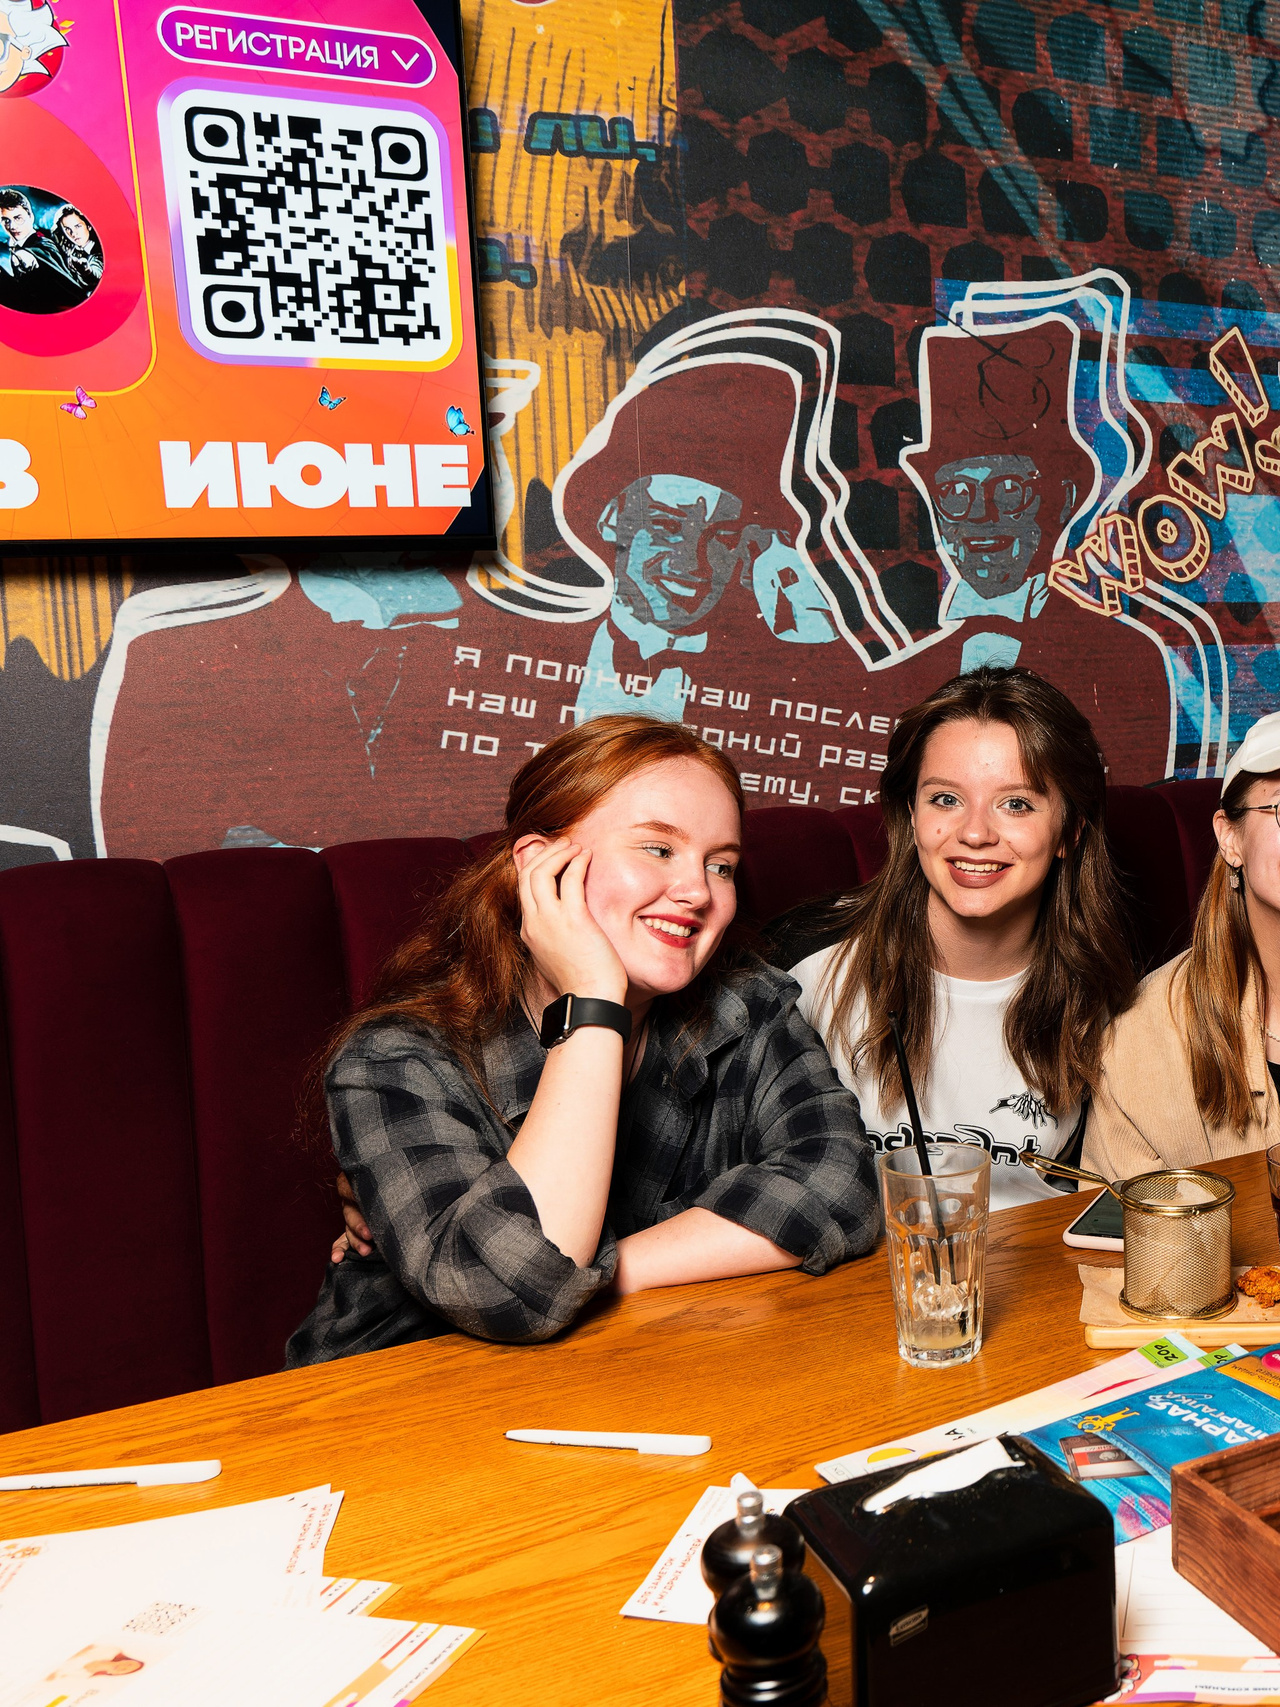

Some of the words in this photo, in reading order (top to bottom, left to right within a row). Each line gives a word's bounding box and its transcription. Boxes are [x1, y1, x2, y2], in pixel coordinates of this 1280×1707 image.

[175, 22, 379, 70] РЕГИСТРАЦИЯ
[159, 440, 472, 509] ИЮНЕ
[1048, 327, 1268, 616] WOW!
[447, 687, 537, 719] наш
[505, 653, 653, 696] помню
[674, 681, 751, 712] наш
[770, 698, 902, 735] после
[440, 729, 500, 757] по
[740, 771, 820, 806] ему,
